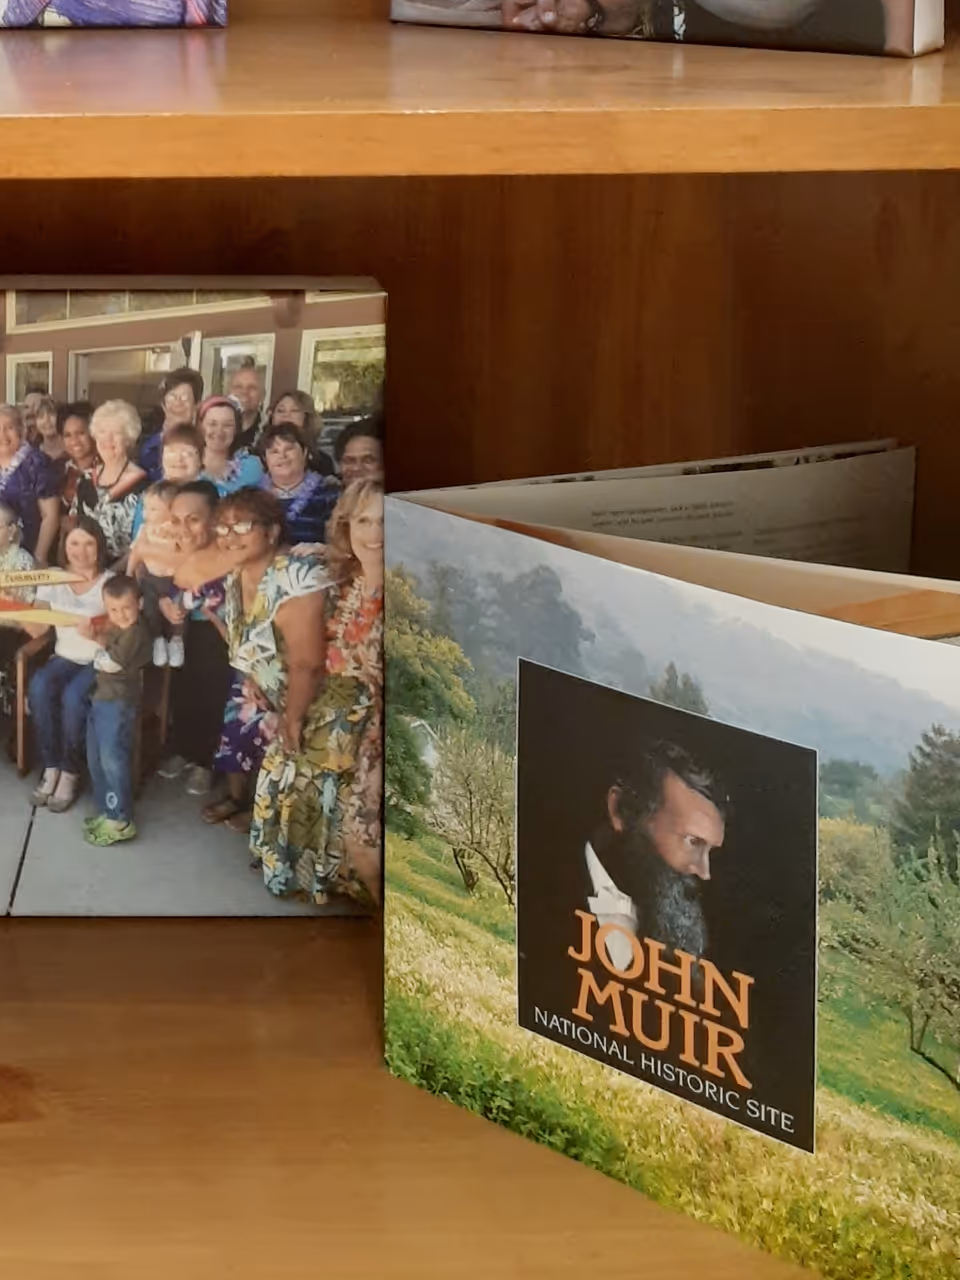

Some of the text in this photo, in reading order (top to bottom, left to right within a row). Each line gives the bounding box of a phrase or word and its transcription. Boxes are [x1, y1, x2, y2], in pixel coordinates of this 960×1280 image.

[567, 909, 755, 1029] JOHN
[572, 967, 753, 1090] MUIR
[534, 1006, 795, 1134] NATIONAL HISTORIC SITE
